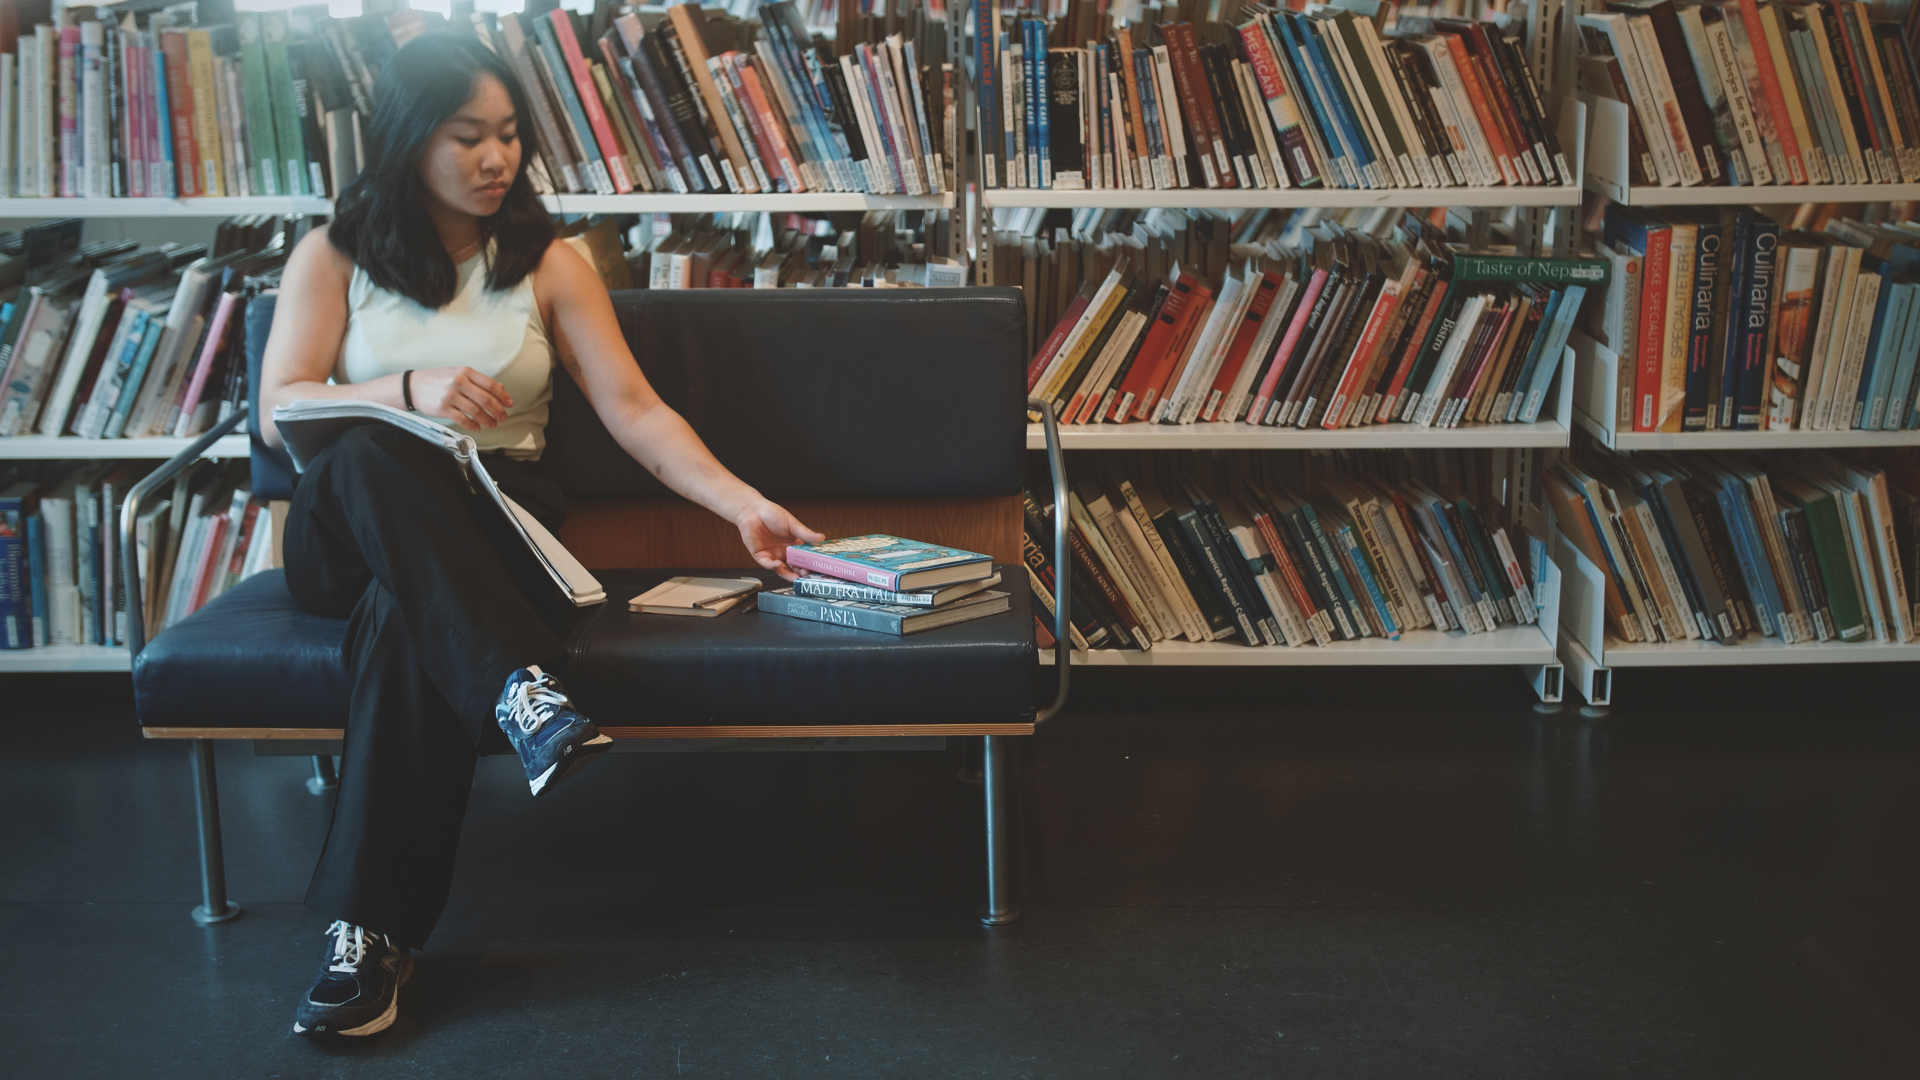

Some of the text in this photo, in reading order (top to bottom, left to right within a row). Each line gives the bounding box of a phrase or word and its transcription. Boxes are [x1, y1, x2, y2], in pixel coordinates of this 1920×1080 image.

[1241, 29, 1277, 95] MEXICAN
[1025, 78, 1033, 102] RIVER
[1038, 78, 1046, 103] RIVER
[1710, 30, 1742, 95] Strandvejen
[1736, 112, 1750, 128] og
[1744, 129, 1755, 144] nu
[1026, 105, 1034, 124] CAFE
[1039, 105, 1047, 125] CAFE
[1474, 260, 1514, 276] Taste
[1517, 262, 1534, 276] of
[1694, 233, 1720, 331] Culinaria
[1746, 230, 1778, 330] Culinaria
[1619, 274, 1636, 376] JAPANESE COOKING
[1644, 236, 1664, 374] FRANSKE SPECIALITETER
[1670, 253, 1689, 358] SPECIALITETER
[1429, 316, 1456, 353] Bistro
[1133, 505, 1148, 522] LA
[1142, 520, 1165, 553] PIZZA
[1351, 504, 1398, 591] Treasure Trove of Hungarian
[1694, 513, 1713, 544] FOODS
[812, 560, 856, 577] ITALIAN CUISINE
[1078, 548, 1100, 577] FRANSKE
[1097, 575, 1119, 603] KØKKEN
[1110, 522, 1157, 600] Recipes and Remembrances
[1184, 558, 1198, 577] FOOD
[1202, 545, 1225, 579] American
[1218, 577, 1240, 609] Regional
[1302, 540, 1326, 574] American
[1317, 572, 1340, 603] Regional
[1354, 556, 1388, 608] VIETNAM
[787, 602, 808, 610] ANTONIO
[787, 607, 817, 618] CARLUCCIO'S
[800, 582, 828, 596] MAD
[835, 584, 859, 598] FRA
[820, 607, 858, 627] PASTA
